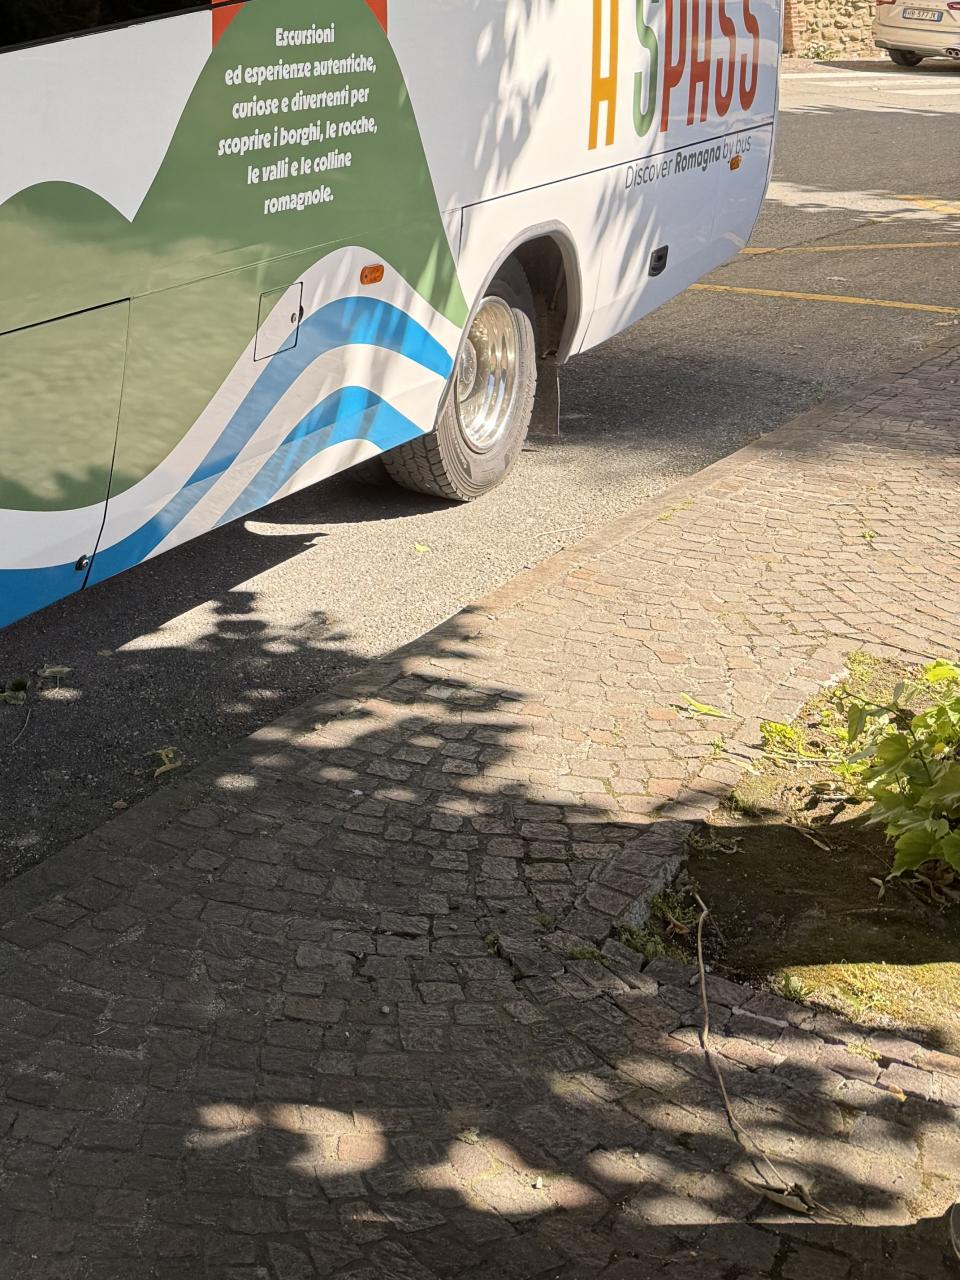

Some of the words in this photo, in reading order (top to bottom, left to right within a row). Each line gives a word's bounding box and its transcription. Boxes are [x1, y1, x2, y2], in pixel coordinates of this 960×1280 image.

[275, 23, 335, 46] Escursioni
[225, 65, 242, 85] ed
[244, 59, 311, 85] esperienze
[314, 53, 376, 76] autentiche,
[232, 96, 278, 119] curiose
[281, 96, 288, 112] e
[291, 85, 349, 111] divertenti
[350, 87, 369, 107] per
[218, 128, 270, 155] scoprire
[274, 126, 278, 146] i
[280, 120, 323, 146] borghi,
[326, 121, 337, 138] le
[339, 116, 377, 137] rocche,
[247, 166, 259, 184] le
[262, 158, 288, 181] valli
[291, 160, 297, 176] e
[301, 157, 312, 175] le
[314, 149, 352, 172] colline
[625, 158, 674, 189] Discover
[674, 149, 721, 173] Romagna
[723, 136, 733, 163] by
[735, 135, 751, 154] bus
[264, 185, 333, 214] romagnole.
